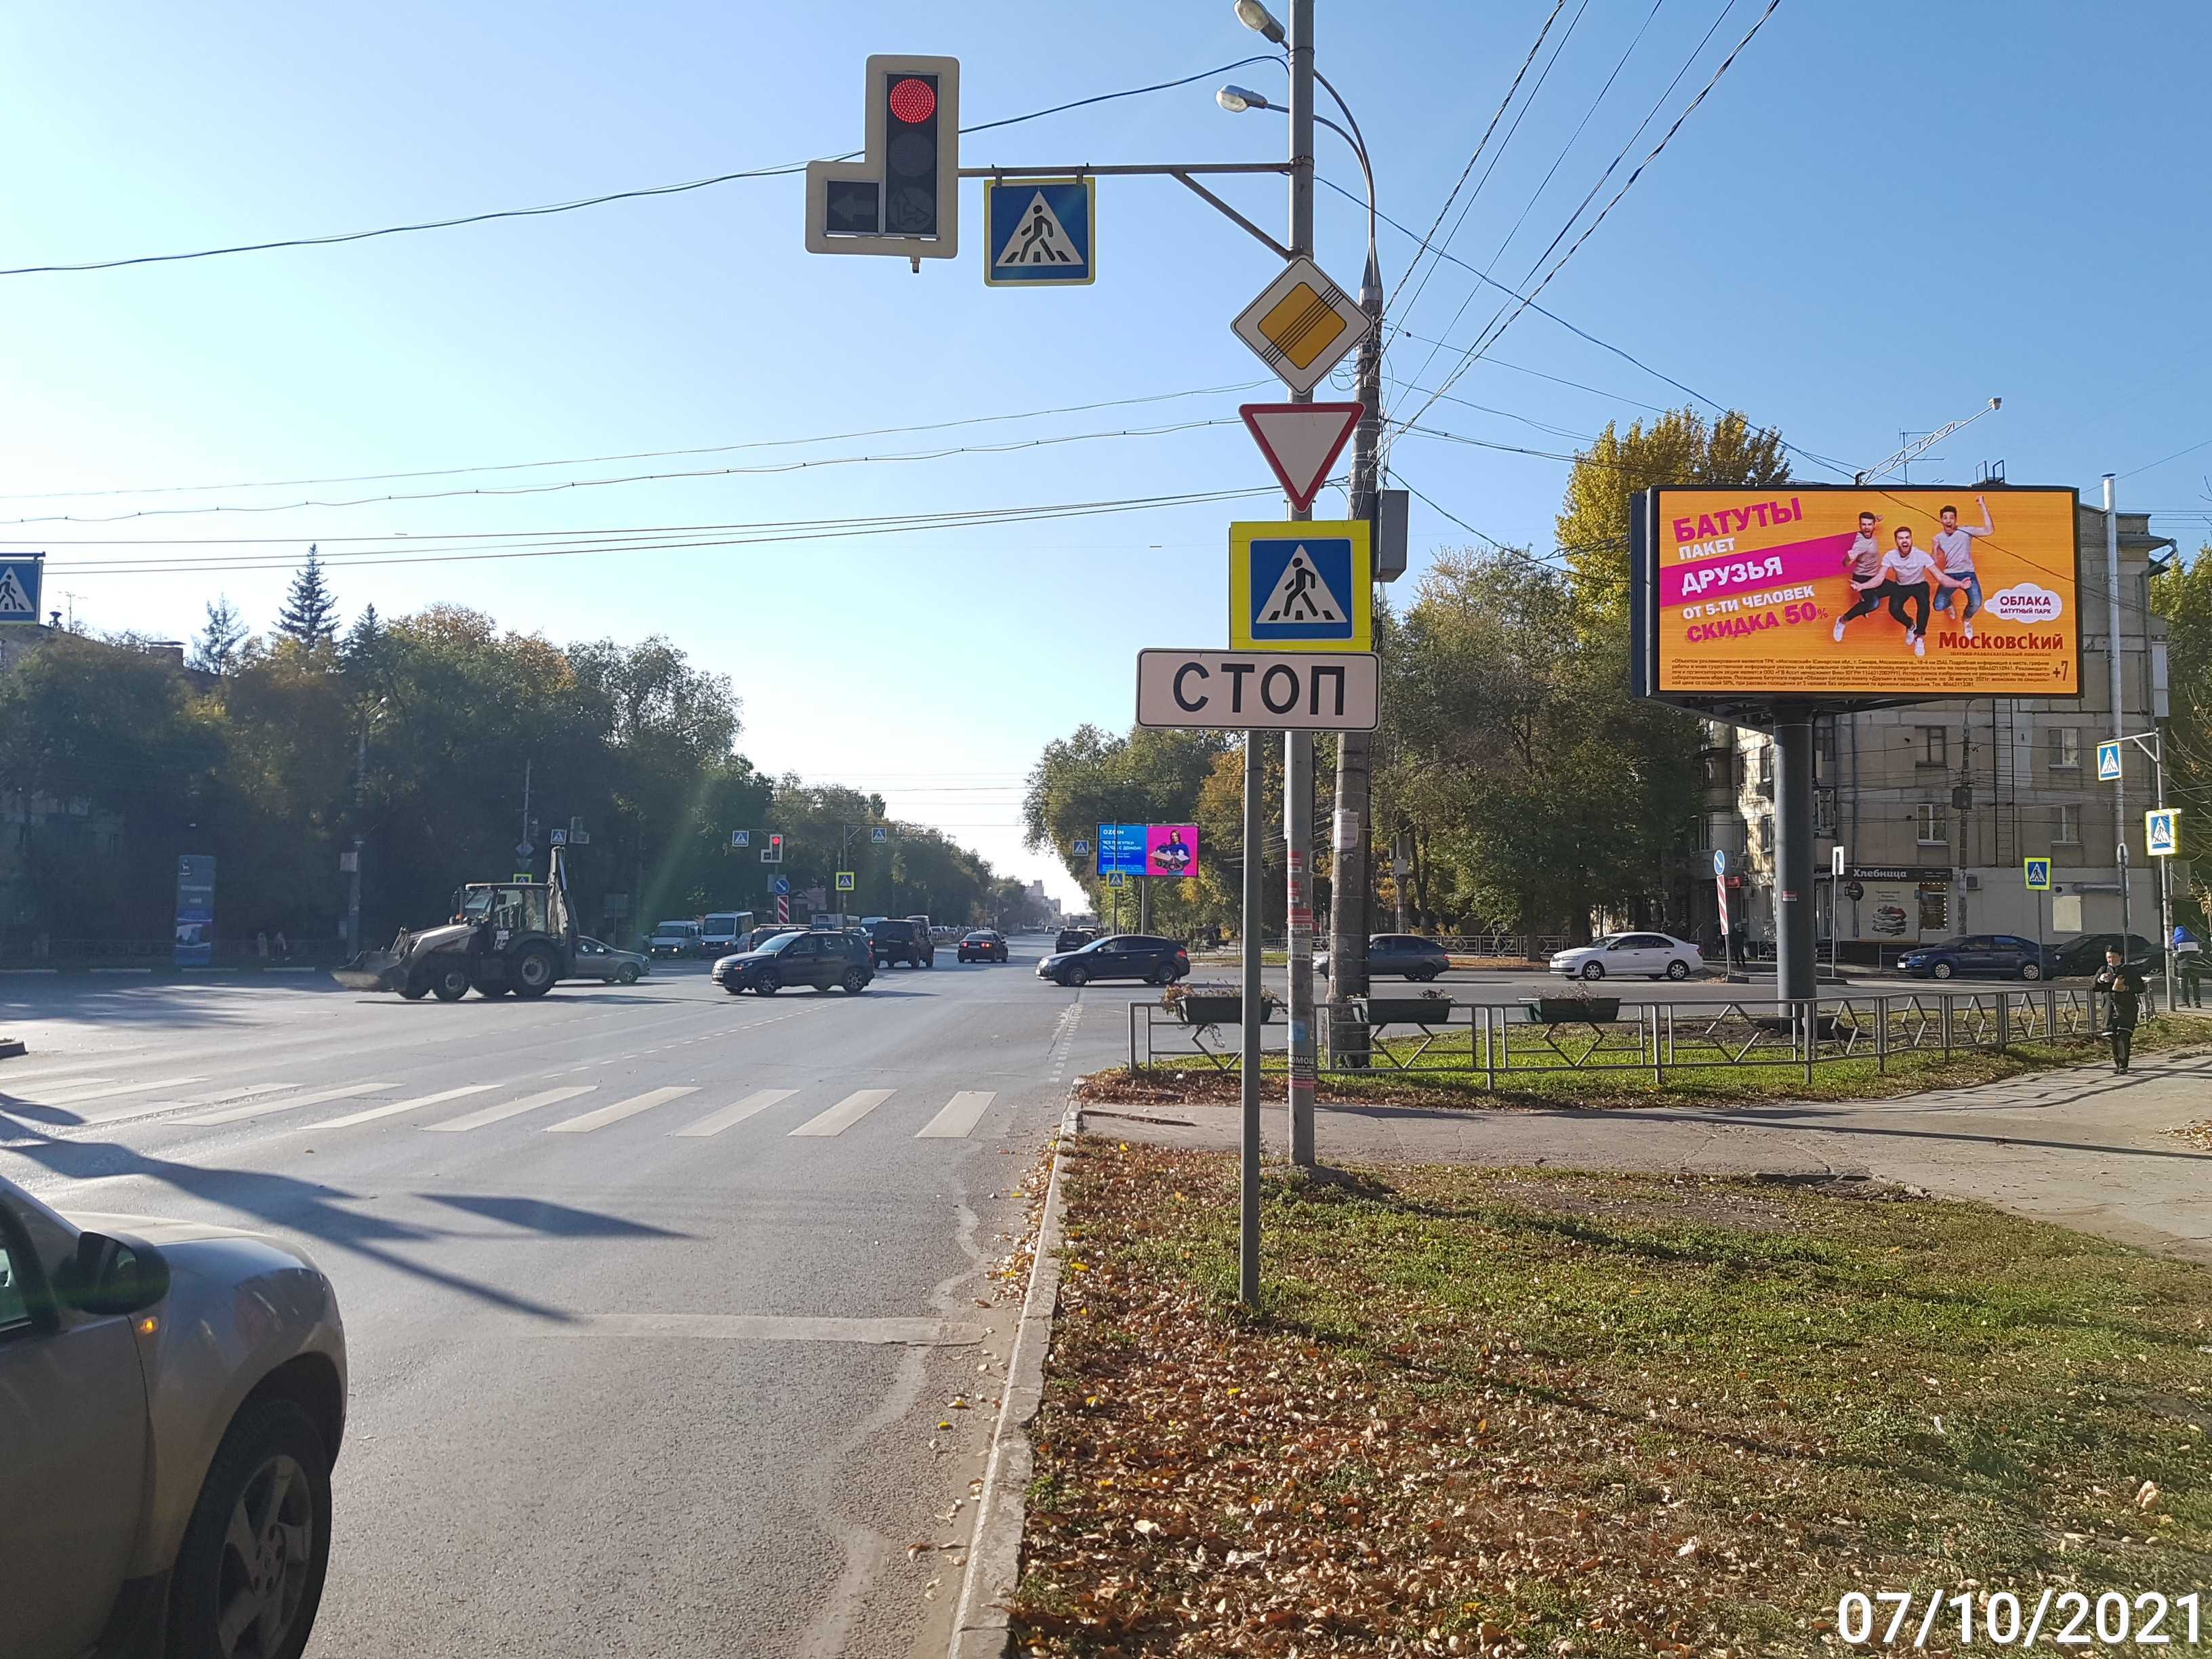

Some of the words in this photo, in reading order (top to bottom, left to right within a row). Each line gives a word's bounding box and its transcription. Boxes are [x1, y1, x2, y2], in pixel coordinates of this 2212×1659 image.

[1673, 497, 1803, 543] БАТУТЫ
[1679, 537, 1735, 560] ПАКЕТ
[1681, 556, 1783, 596] ДРУЗЬЯ
[1683, 606, 1702, 619] ОТ
[1706, 599, 1739, 615] 5-ТИ
[1742, 585, 1815, 608] ЧЕЛОВЕК
[2000, 596, 2051, 606] ОБЛАКА
[1687, 611, 1780, 642] СКИДКА
[1784, 602, 1828, 624] 50%
[1939, 632, 2064, 649] Московский
[2053, 660, 2068, 681] +7
[1173, 662, 1345, 716] СТОП
[1853, 869, 1907, 879] Хлебница
